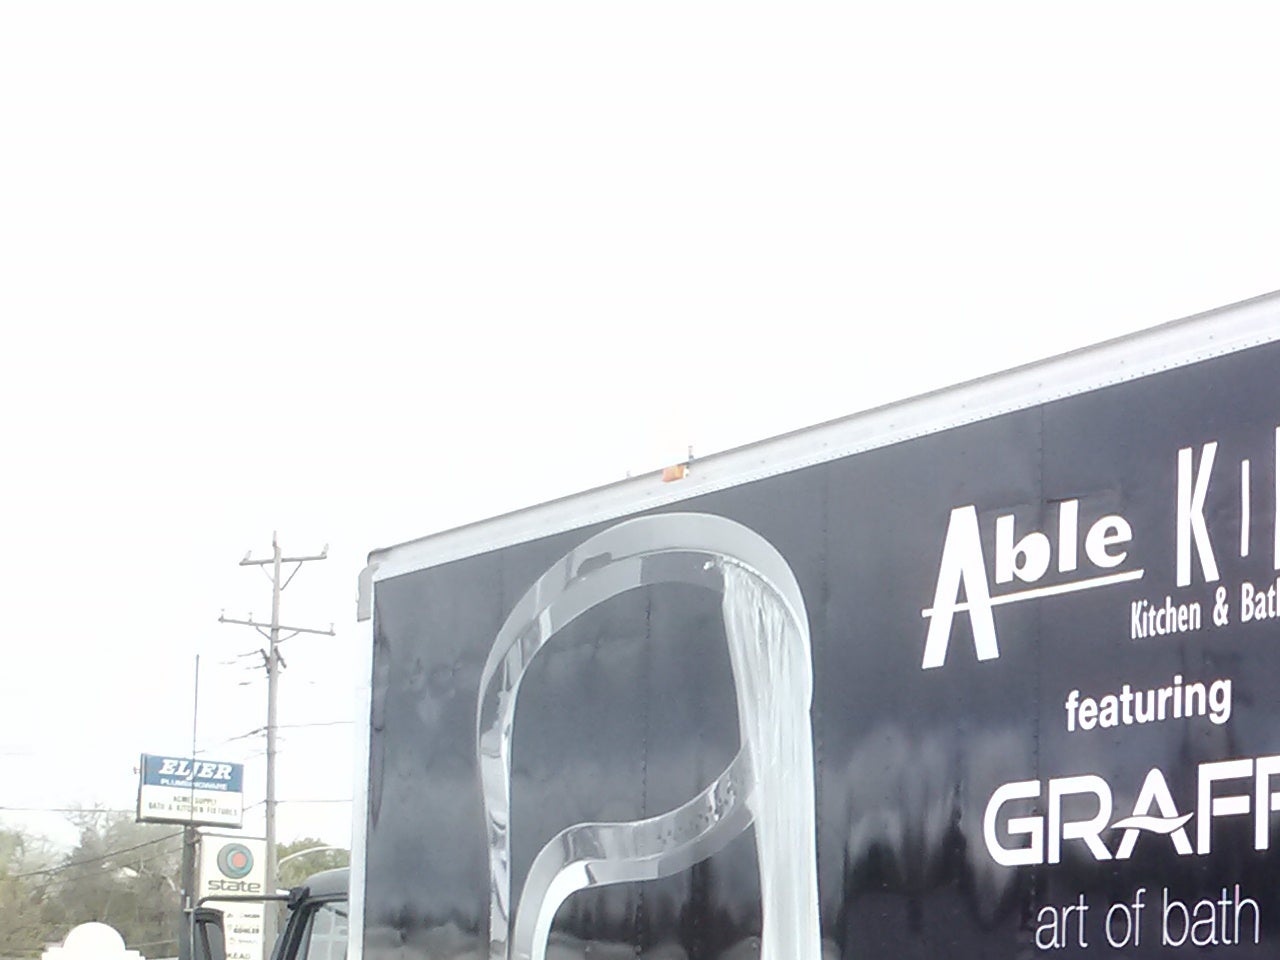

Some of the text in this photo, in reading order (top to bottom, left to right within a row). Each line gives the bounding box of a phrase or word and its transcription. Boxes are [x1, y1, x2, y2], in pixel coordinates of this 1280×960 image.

[922, 500, 1144, 669] Able
[1131, 597, 1200, 639] Kitchen
[1213, 587, 1228, 625] &
[1065, 675, 1232, 731] featuring
[158, 759, 233, 780] ELJER
[208, 879, 261, 893] state
[1035, 884, 1260, 949] art of bath
